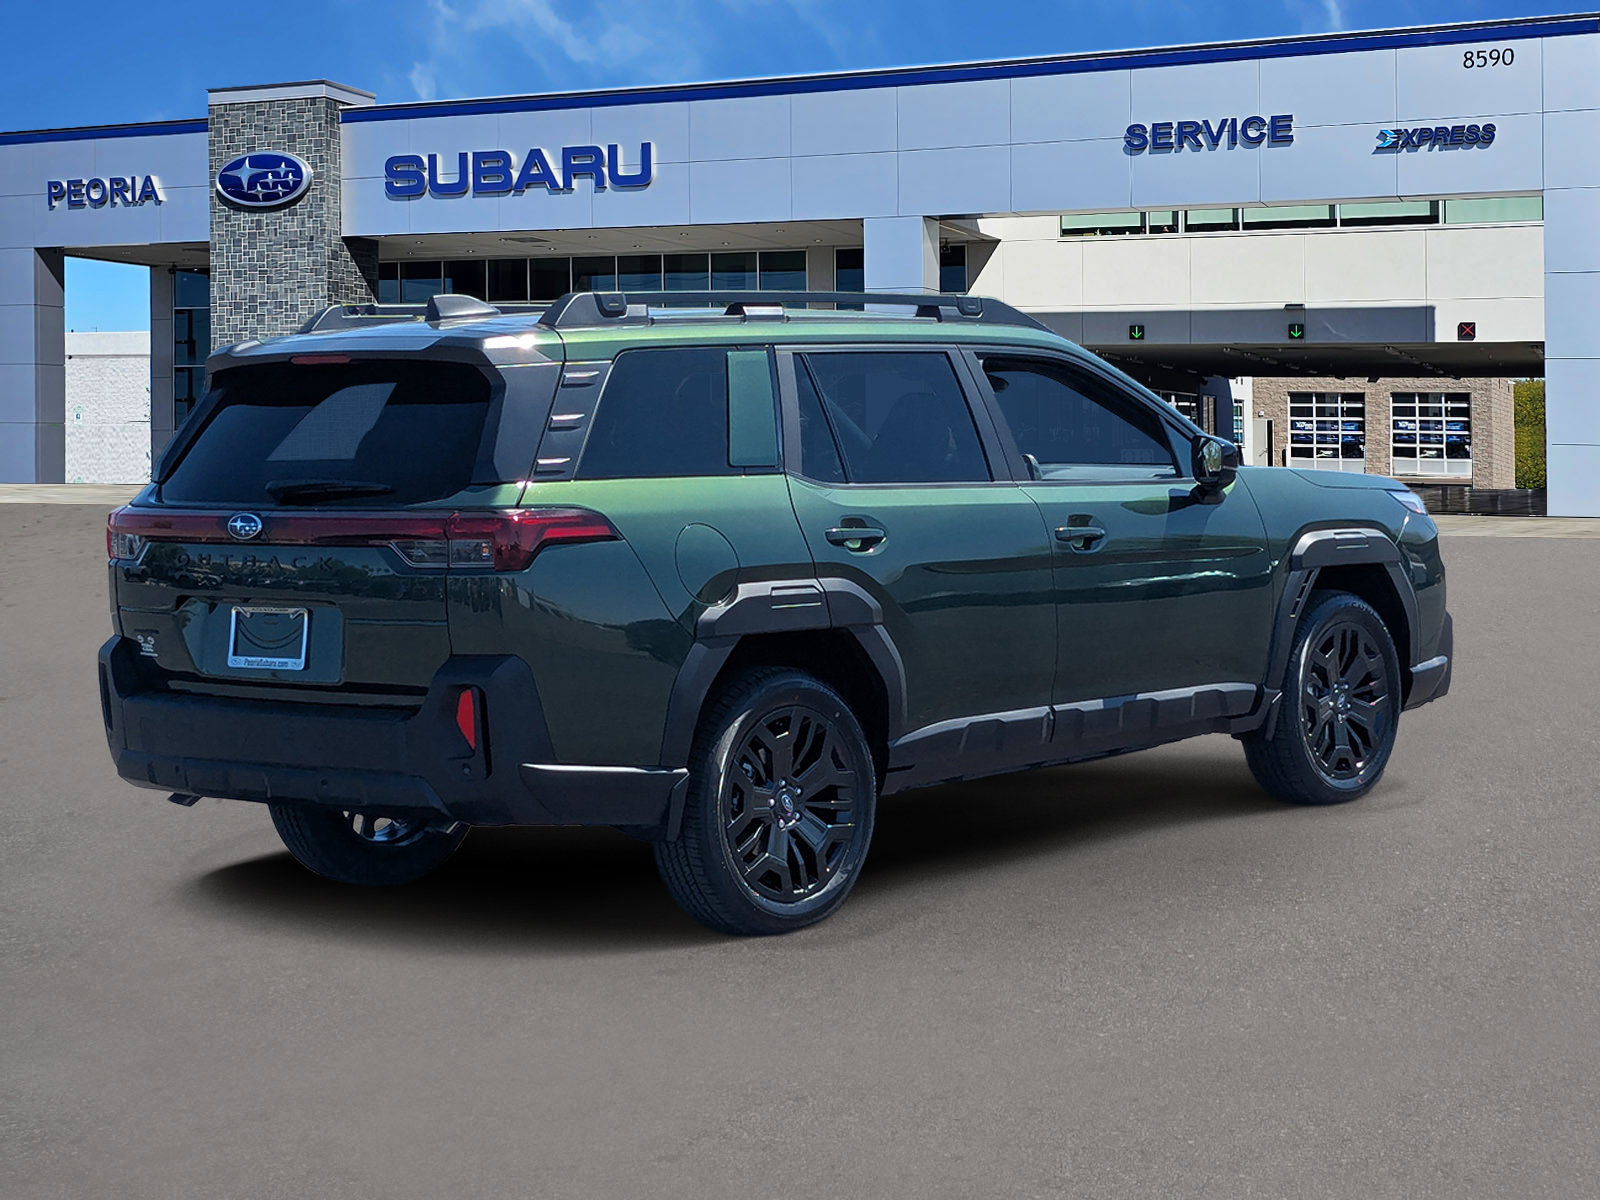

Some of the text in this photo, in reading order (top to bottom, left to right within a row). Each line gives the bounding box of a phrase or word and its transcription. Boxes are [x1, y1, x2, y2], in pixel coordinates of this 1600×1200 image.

[1462, 48, 1515, 69] 8590
[1125, 114, 1294, 152] SERVICE
[1376, 123, 1497, 151] EXPRESS
[384, 141, 652, 197] SUBARU
[47, 175, 161, 208] PEORIA
[176, 552, 333, 571] OUTBACK
